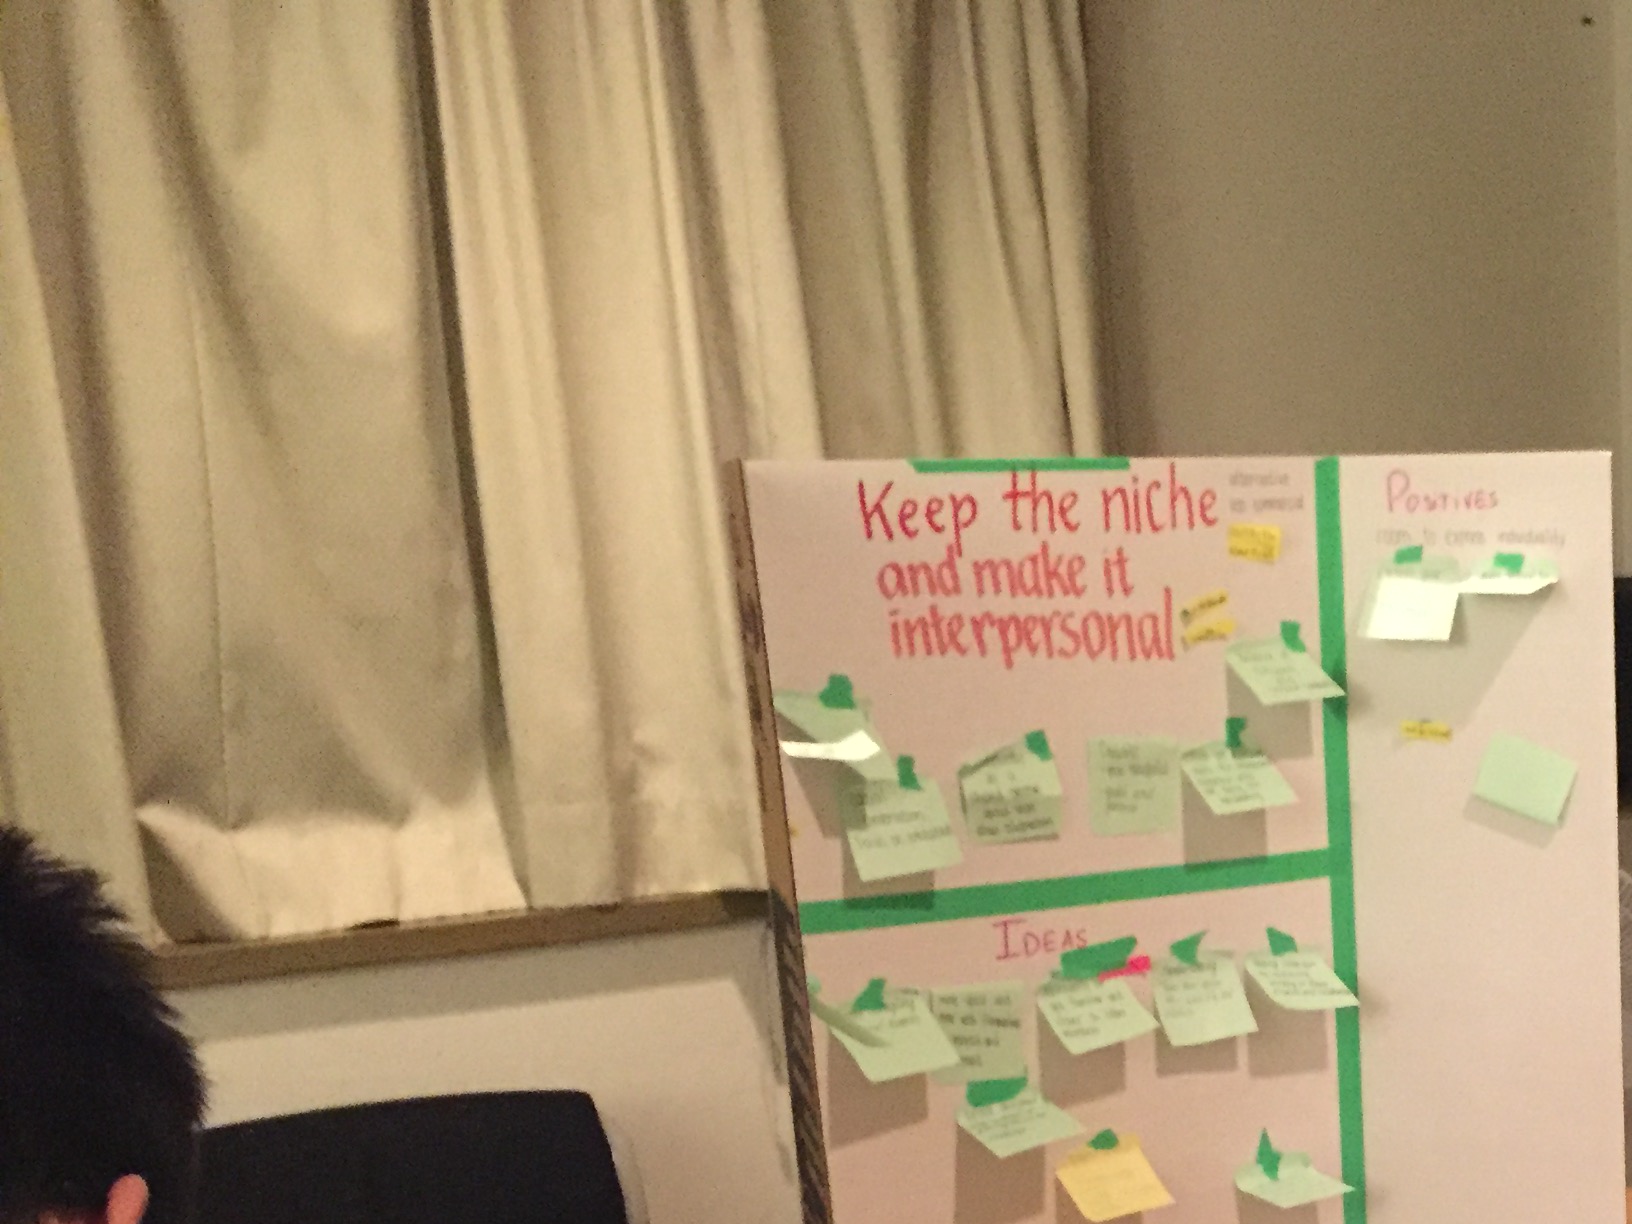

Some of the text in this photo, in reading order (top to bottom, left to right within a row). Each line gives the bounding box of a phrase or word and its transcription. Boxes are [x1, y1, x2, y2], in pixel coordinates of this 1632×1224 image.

[858, 462, 1218, 557] Keep the niche
[877, 541, 1134, 599] and make it
[888, 586, 1176, 670] interpersonal
